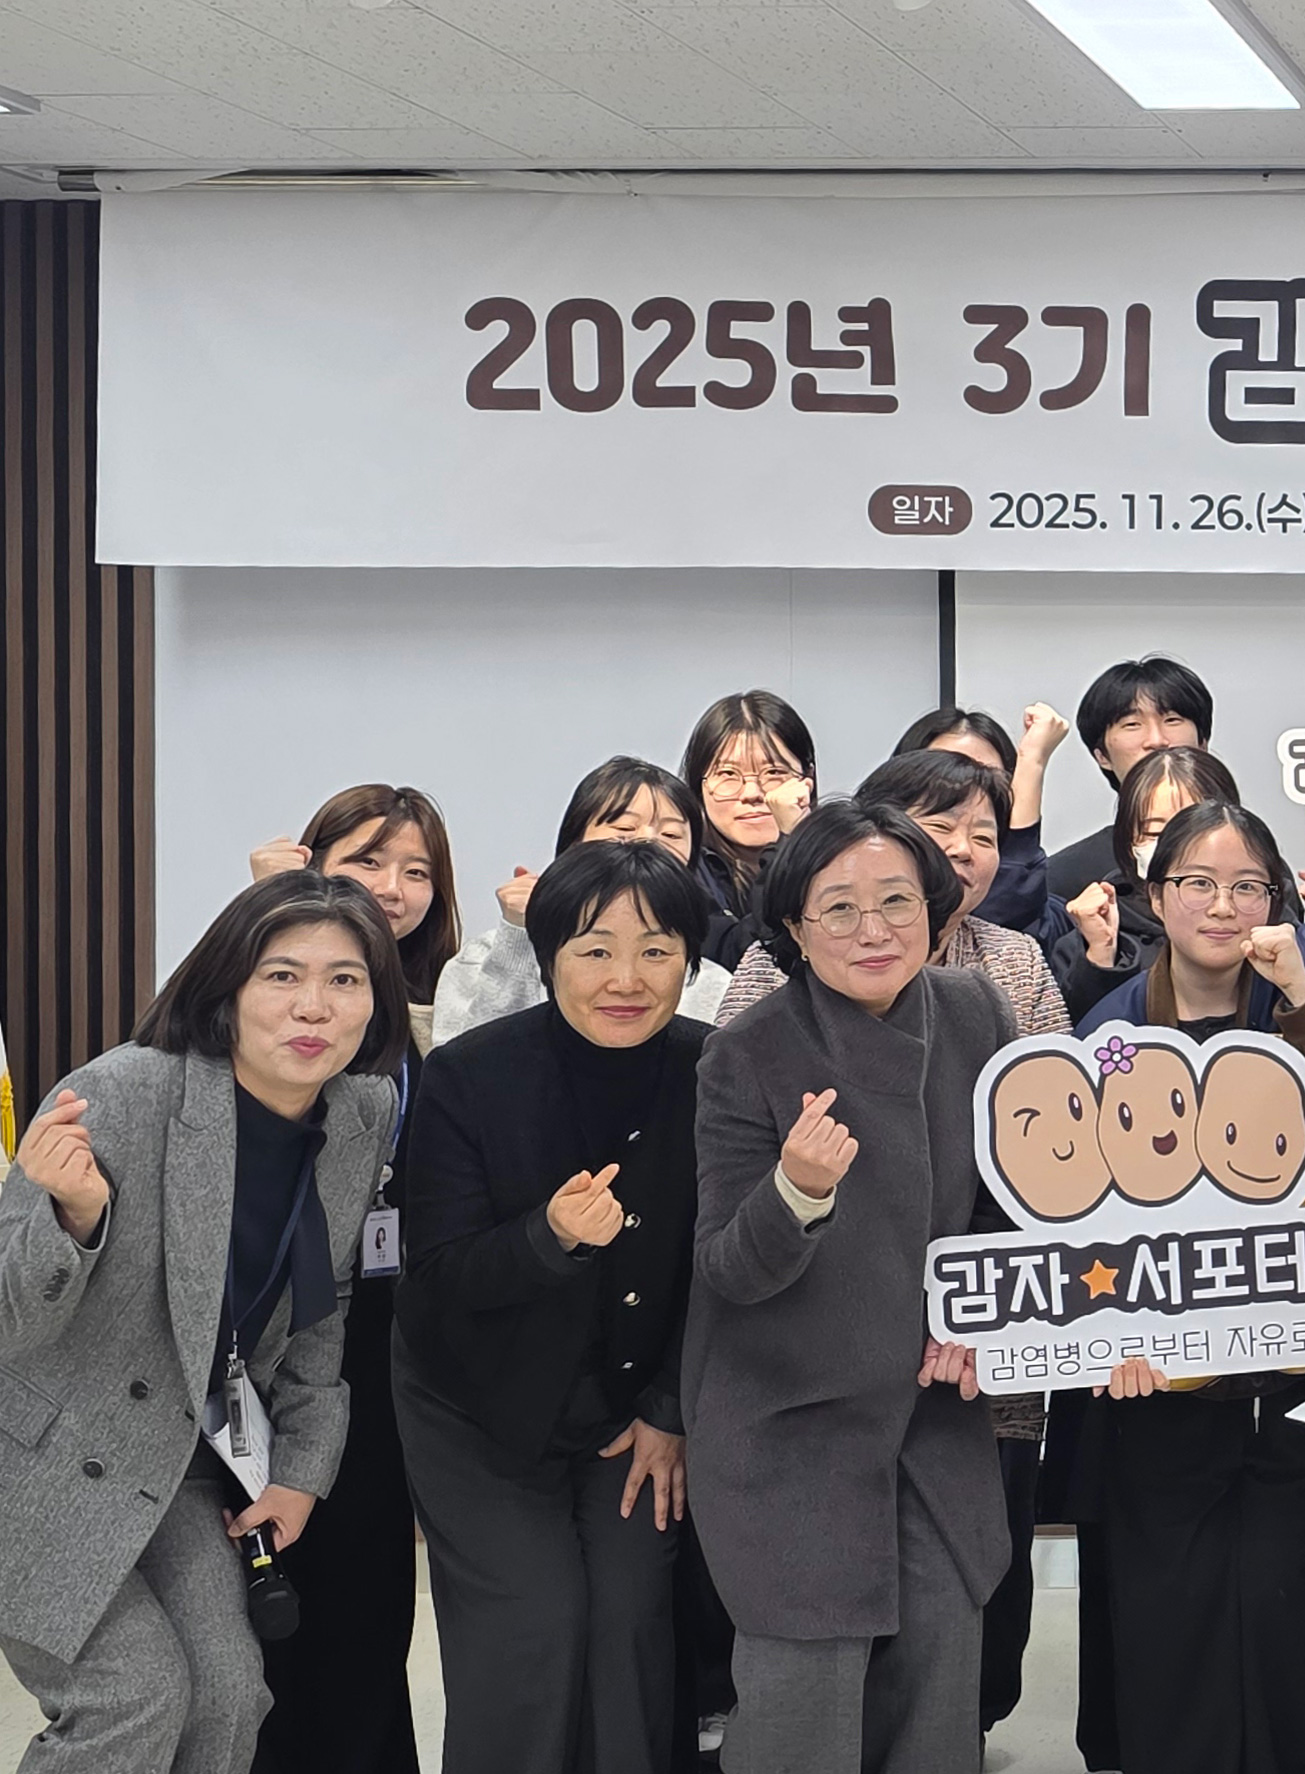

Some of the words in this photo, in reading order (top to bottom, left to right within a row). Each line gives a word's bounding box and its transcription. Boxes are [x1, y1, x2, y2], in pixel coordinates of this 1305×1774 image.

[464, 296, 899, 414] 2025년
[962, 302, 1152, 416] 3기
[891, 494, 954, 526] 일자
[988, 491, 1107, 531] 2025.
[1121, 493, 1180, 531] 11.
[941, 1250, 1070, 1325] 감자
